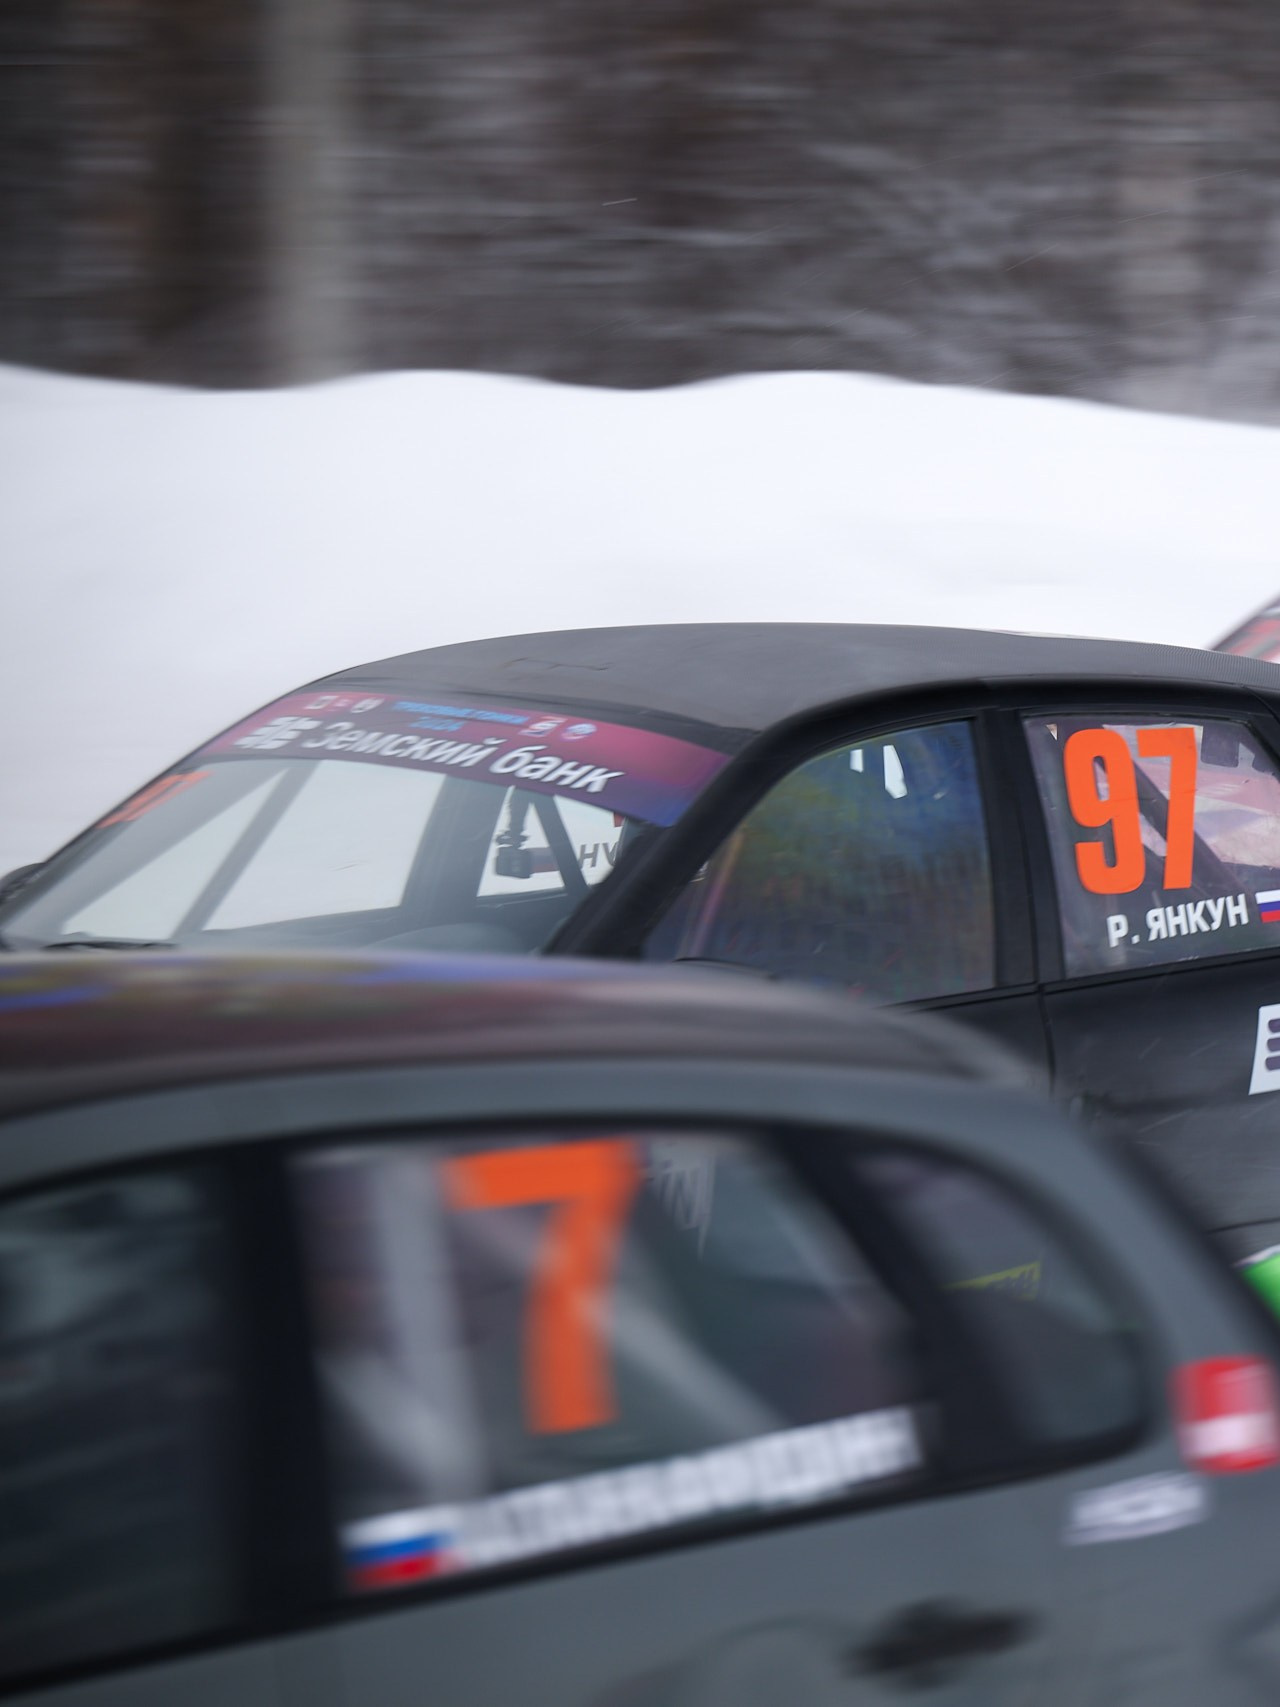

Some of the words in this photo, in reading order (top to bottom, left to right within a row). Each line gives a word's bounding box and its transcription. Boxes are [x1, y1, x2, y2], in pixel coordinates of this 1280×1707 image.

[302, 721, 508, 768] Земский
[489, 745, 626, 794] банк
[1062, 726, 1199, 896] 97
[1106, 913, 1142, 948] Р.
[1146, 892, 1250, 943] ЯНКУН
[442, 1138, 645, 1436] 7
